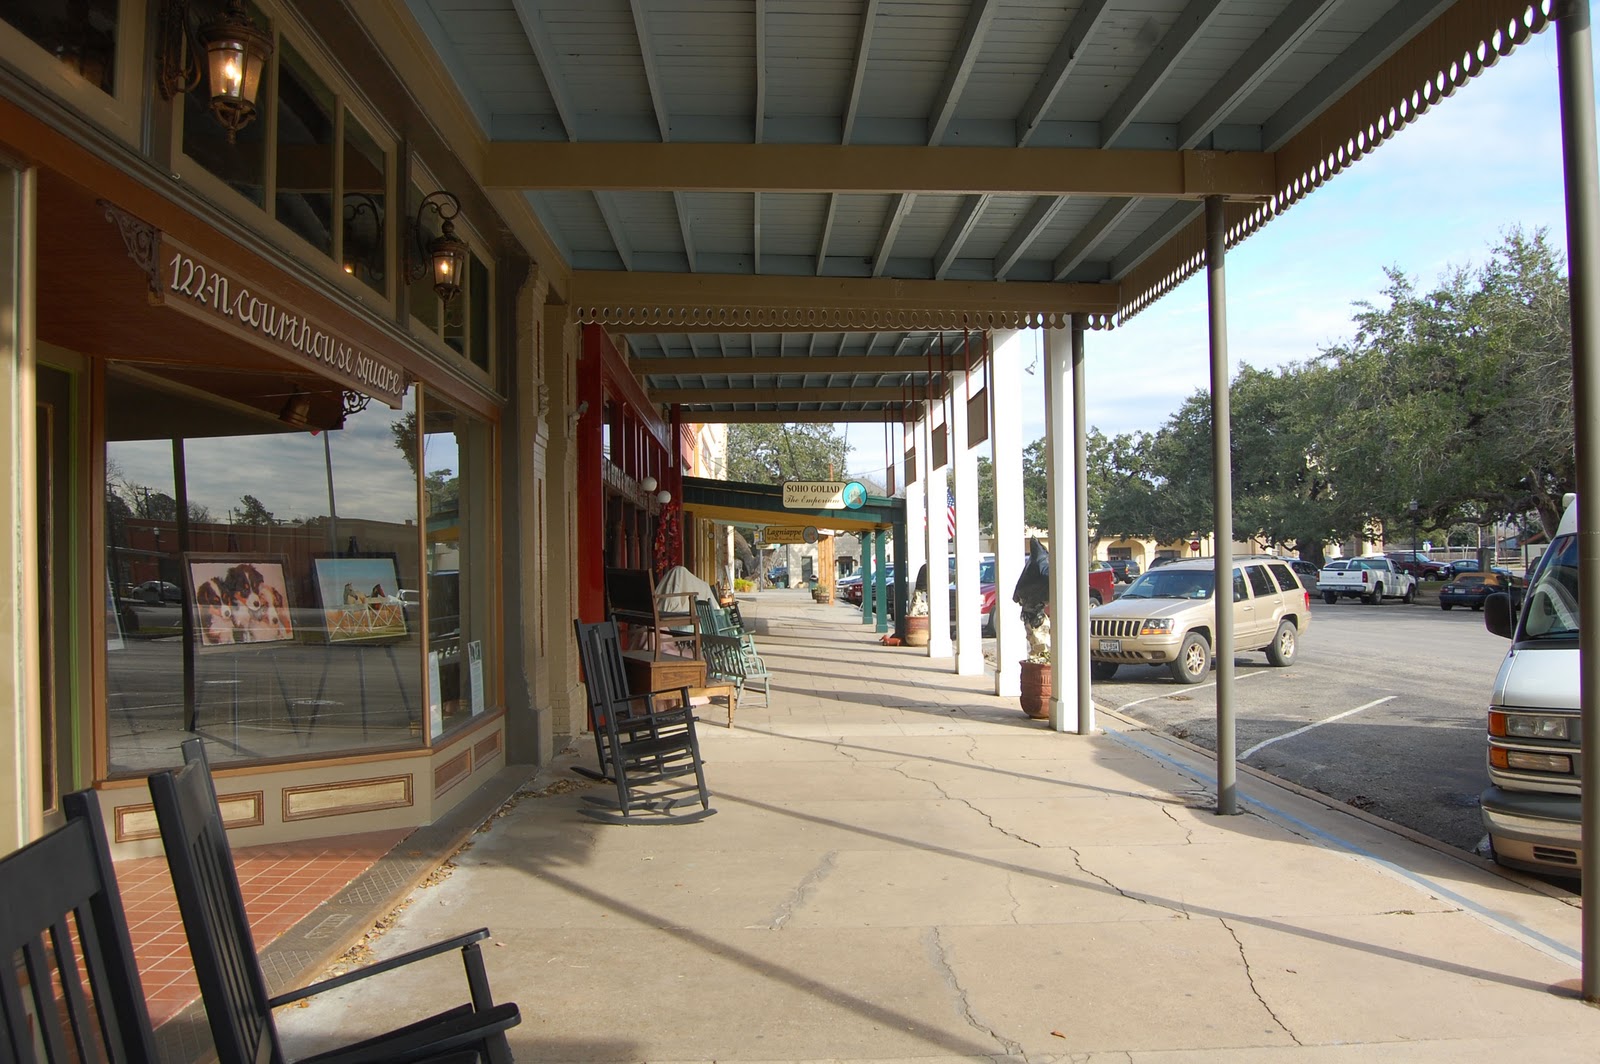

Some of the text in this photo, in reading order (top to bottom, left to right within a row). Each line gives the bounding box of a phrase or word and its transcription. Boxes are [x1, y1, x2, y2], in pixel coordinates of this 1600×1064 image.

[786, 485, 840, 493] SOHO GOLIAD
[784, 494, 799, 503] The
[767, 528, 802, 538] Lagniappe
